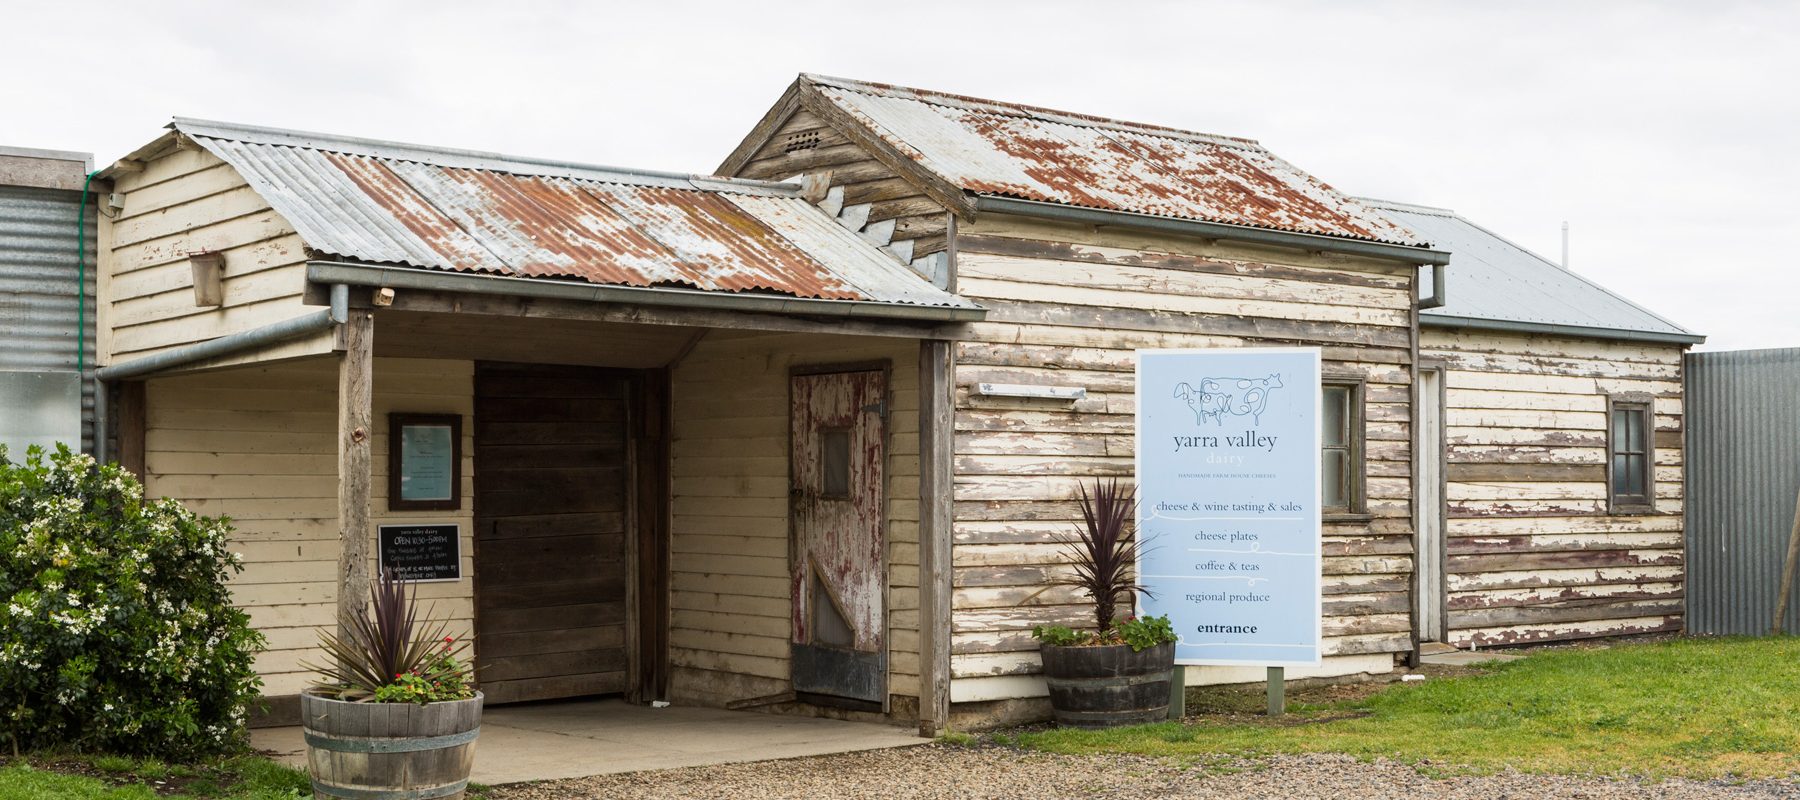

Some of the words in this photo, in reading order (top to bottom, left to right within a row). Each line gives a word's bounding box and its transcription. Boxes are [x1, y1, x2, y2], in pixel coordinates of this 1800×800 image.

[1173, 436, 1218, 452] yarra
[1226, 430, 1278, 452] valley
[1206, 452, 1244, 467] dairy
[1156, 501, 1188, 512] cheese
[1191, 502, 1200, 512] &
[1204, 502, 1229, 512] wine
[1232, 502, 1265, 514] tasting
[1267, 502, 1277, 512] &
[1280, 501, 1302, 512] sales
[1194, 531, 1227, 541] cheese
[1230, 531, 1258, 543] plates
[1195, 560, 1225, 571] coffee
[1228, 562, 1237, 571] &
[1241, 563, 1260, 571] teas
[1185, 592, 1226, 603] regional
[1229, 592, 1270, 604] produce
[1197, 624, 1258, 634] entrance
